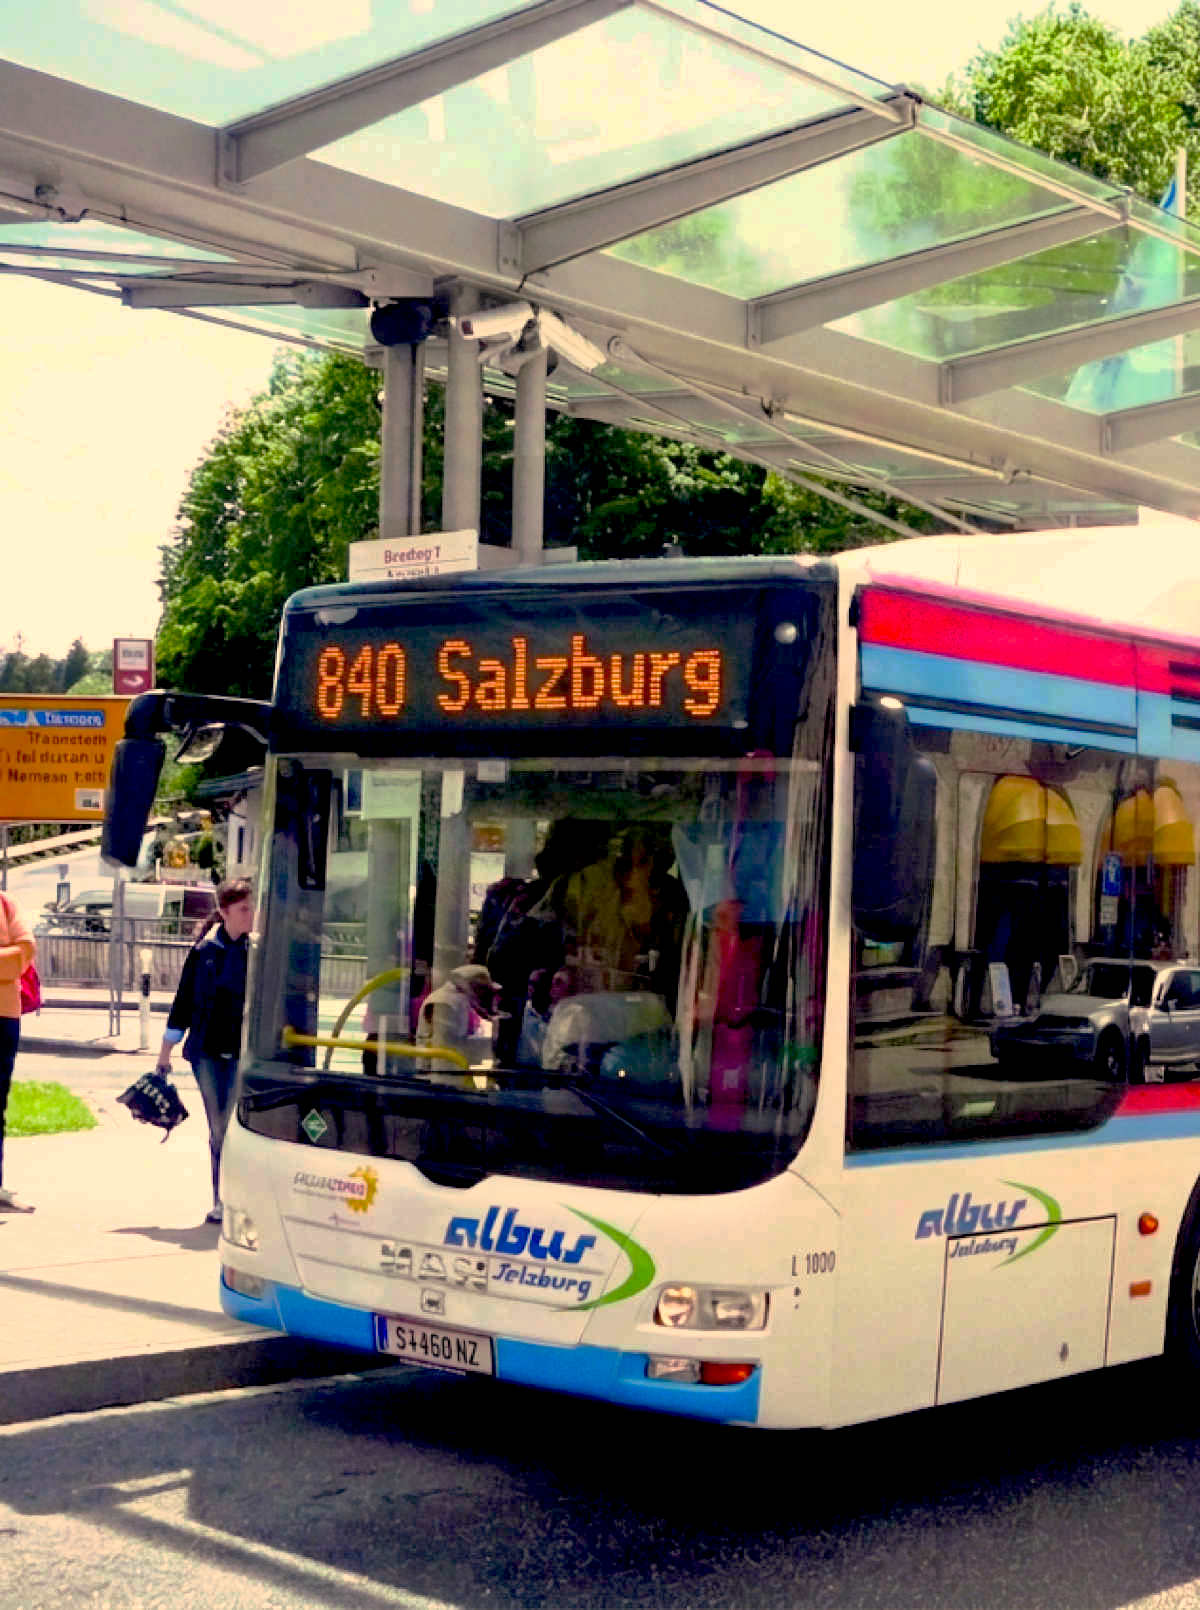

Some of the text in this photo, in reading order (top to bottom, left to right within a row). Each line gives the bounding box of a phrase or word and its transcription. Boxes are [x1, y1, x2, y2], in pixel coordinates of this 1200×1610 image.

[317, 633, 721, 718] 840 Salzburg
[443, 1205, 597, 1264] albus
[914, 1192, 1028, 1240] albus
